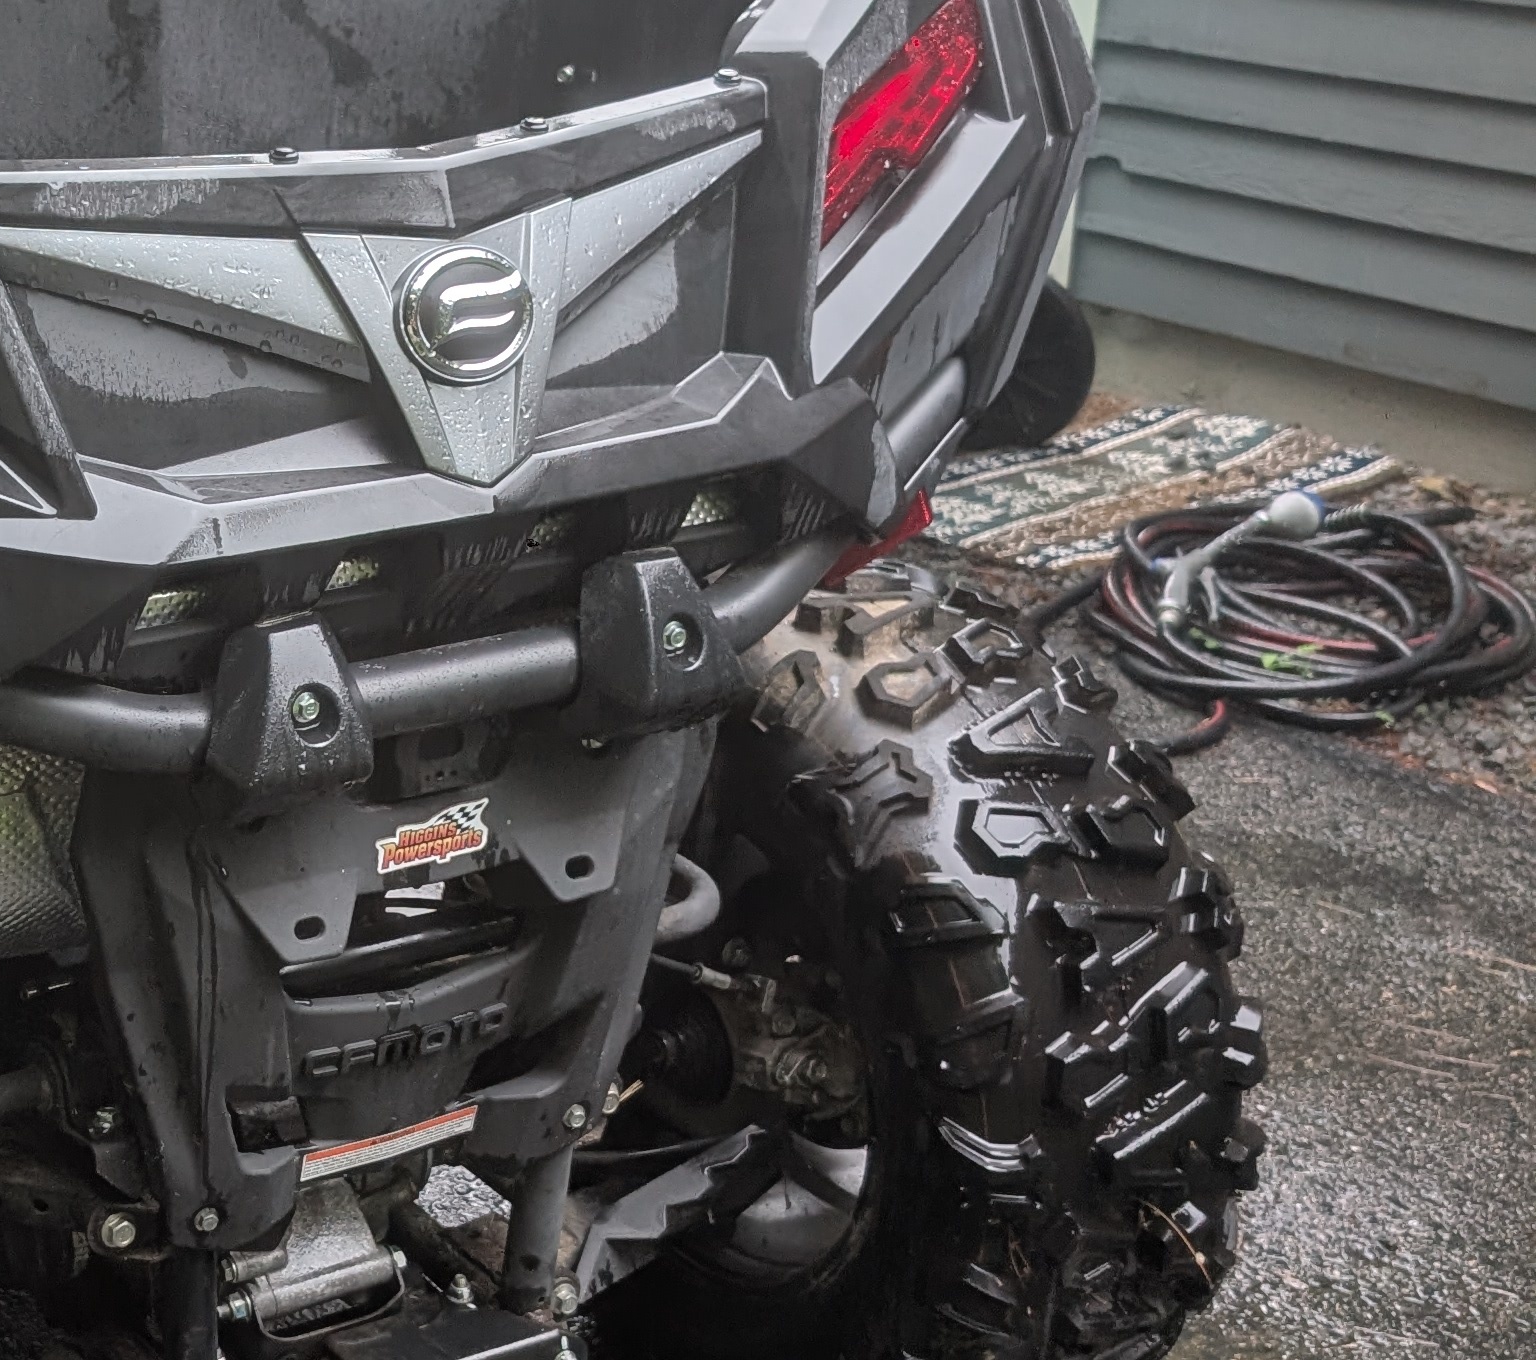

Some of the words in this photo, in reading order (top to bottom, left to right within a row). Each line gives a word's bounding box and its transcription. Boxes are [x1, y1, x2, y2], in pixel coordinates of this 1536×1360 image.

[380, 827, 483, 870] Powersports
[398, 821, 458, 848] HIGGINS
[302, 1001, 509, 1078] CFMOTO
